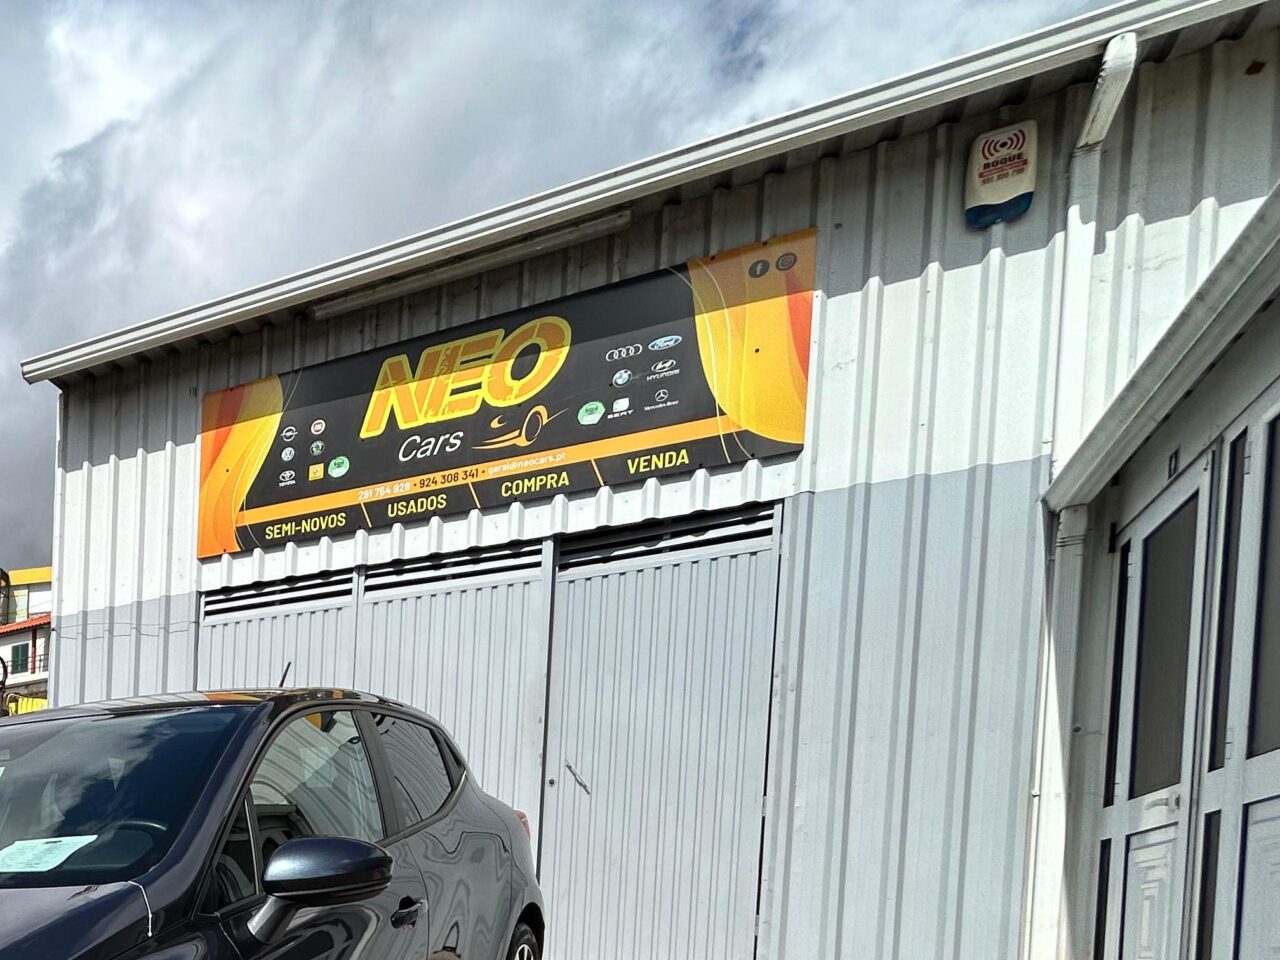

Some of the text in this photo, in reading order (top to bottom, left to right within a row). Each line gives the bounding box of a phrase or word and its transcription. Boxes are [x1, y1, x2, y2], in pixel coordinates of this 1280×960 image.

[359, 316, 571, 439] NEO
[398, 431, 464, 462] Cars
[419, 476, 438, 488] 924
[440, 472, 459, 484] 308
[461, 468, 479, 481] 341
[487, 452, 566, 475] geral@neocars.pt
[265, 449, 689, 540] SEMI-NOVOS USADOS COMPRA VENDA
